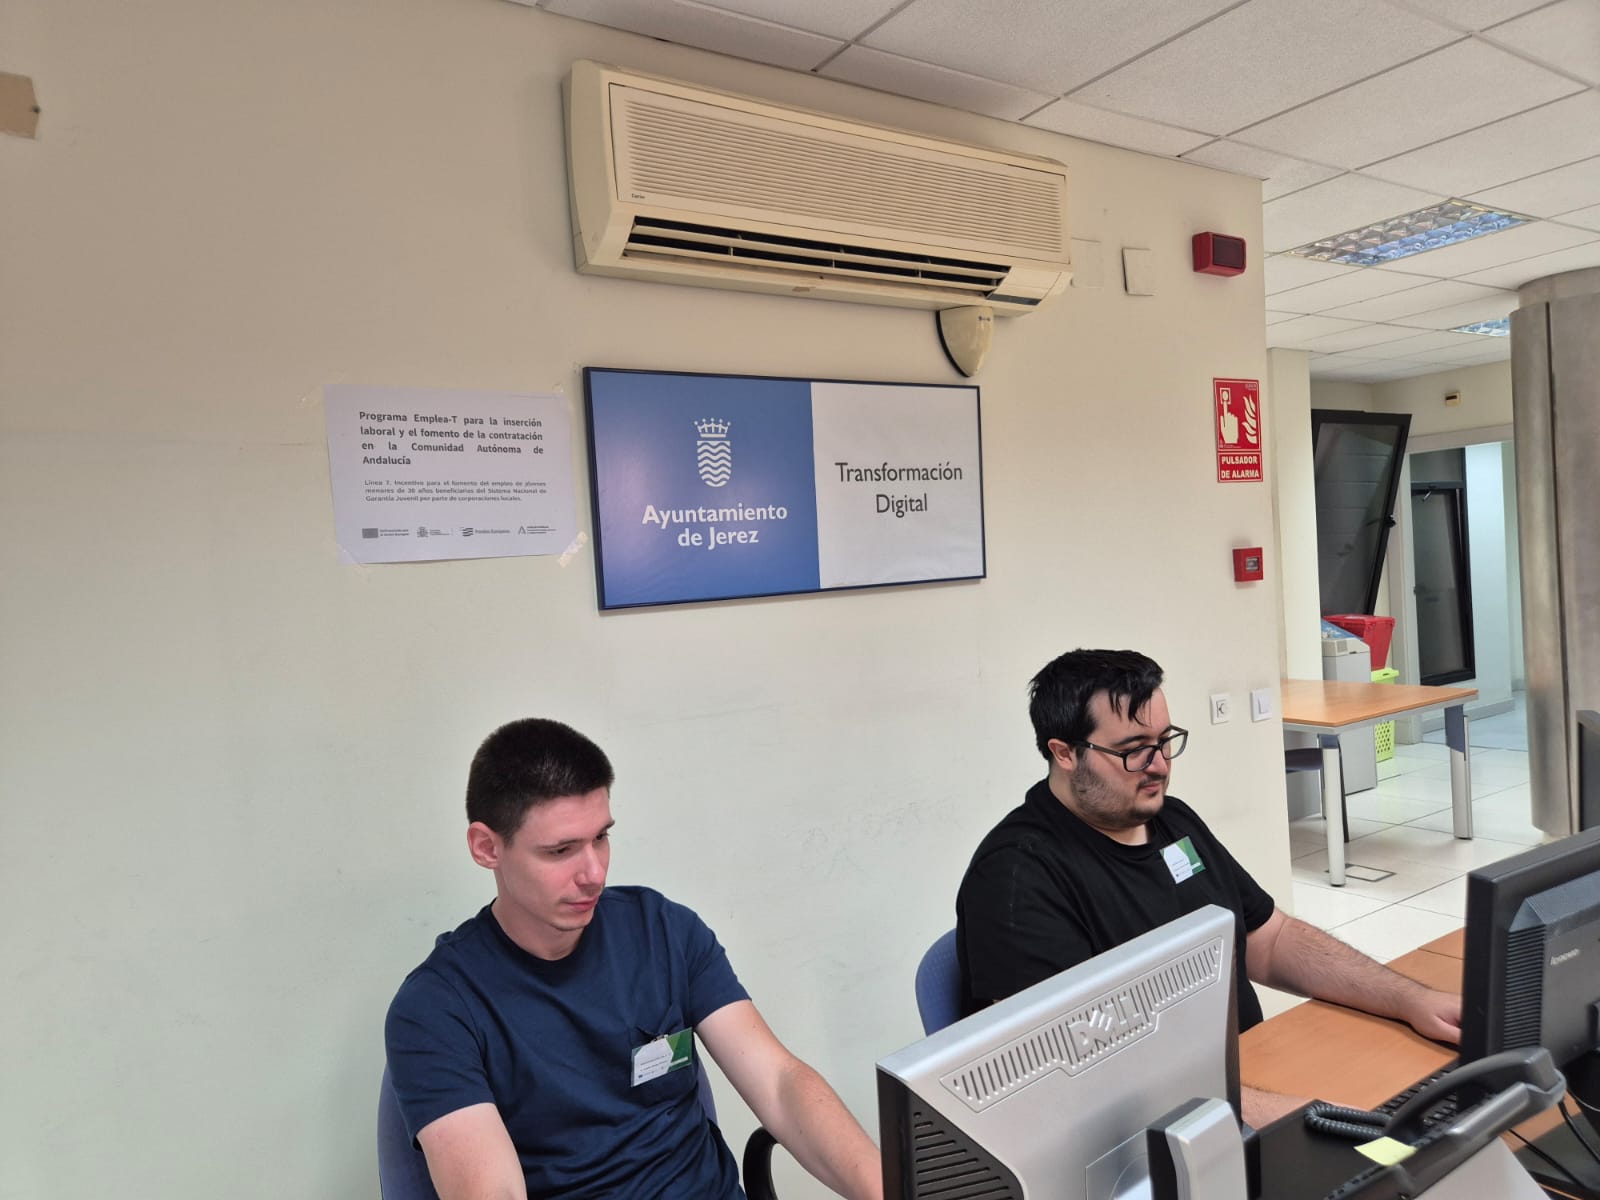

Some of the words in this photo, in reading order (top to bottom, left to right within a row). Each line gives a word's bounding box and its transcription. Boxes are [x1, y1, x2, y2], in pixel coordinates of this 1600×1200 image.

[360, 411, 407, 422] Programa
[414, 414, 457, 424] Emplea-T
[464, 417, 483, 426] para
[490, 416, 497, 425] la
[503, 418, 542, 427] inserción
[360, 426, 395, 436] laboral
[399, 429, 404, 438] y
[408, 428, 417, 437] el
[420, 428, 459, 438] fomento
[463, 430, 474, 439] de
[477, 430, 485, 439] la
[489, 431, 542, 441] contratación
[361, 442, 374, 450] en
[388, 441, 397, 450] la
[411, 442, 463, 452] Comunidad
[477, 443, 521, 454] Autónoma
[533, 446, 543, 454] de
[362, 455, 411, 465] Andalucía
[1221, 455, 1258, 465] PULSADOR
[835, 460, 963, 482] Transformación
[1221, 470, 1230, 479] DE
[1232, 469, 1260, 479] ALARMA
[876, 493, 927, 518] Digital
[642, 502, 788, 530] Ayuntamiento
[678, 527, 703, 547] de
[709, 526, 759, 551] Jerez
